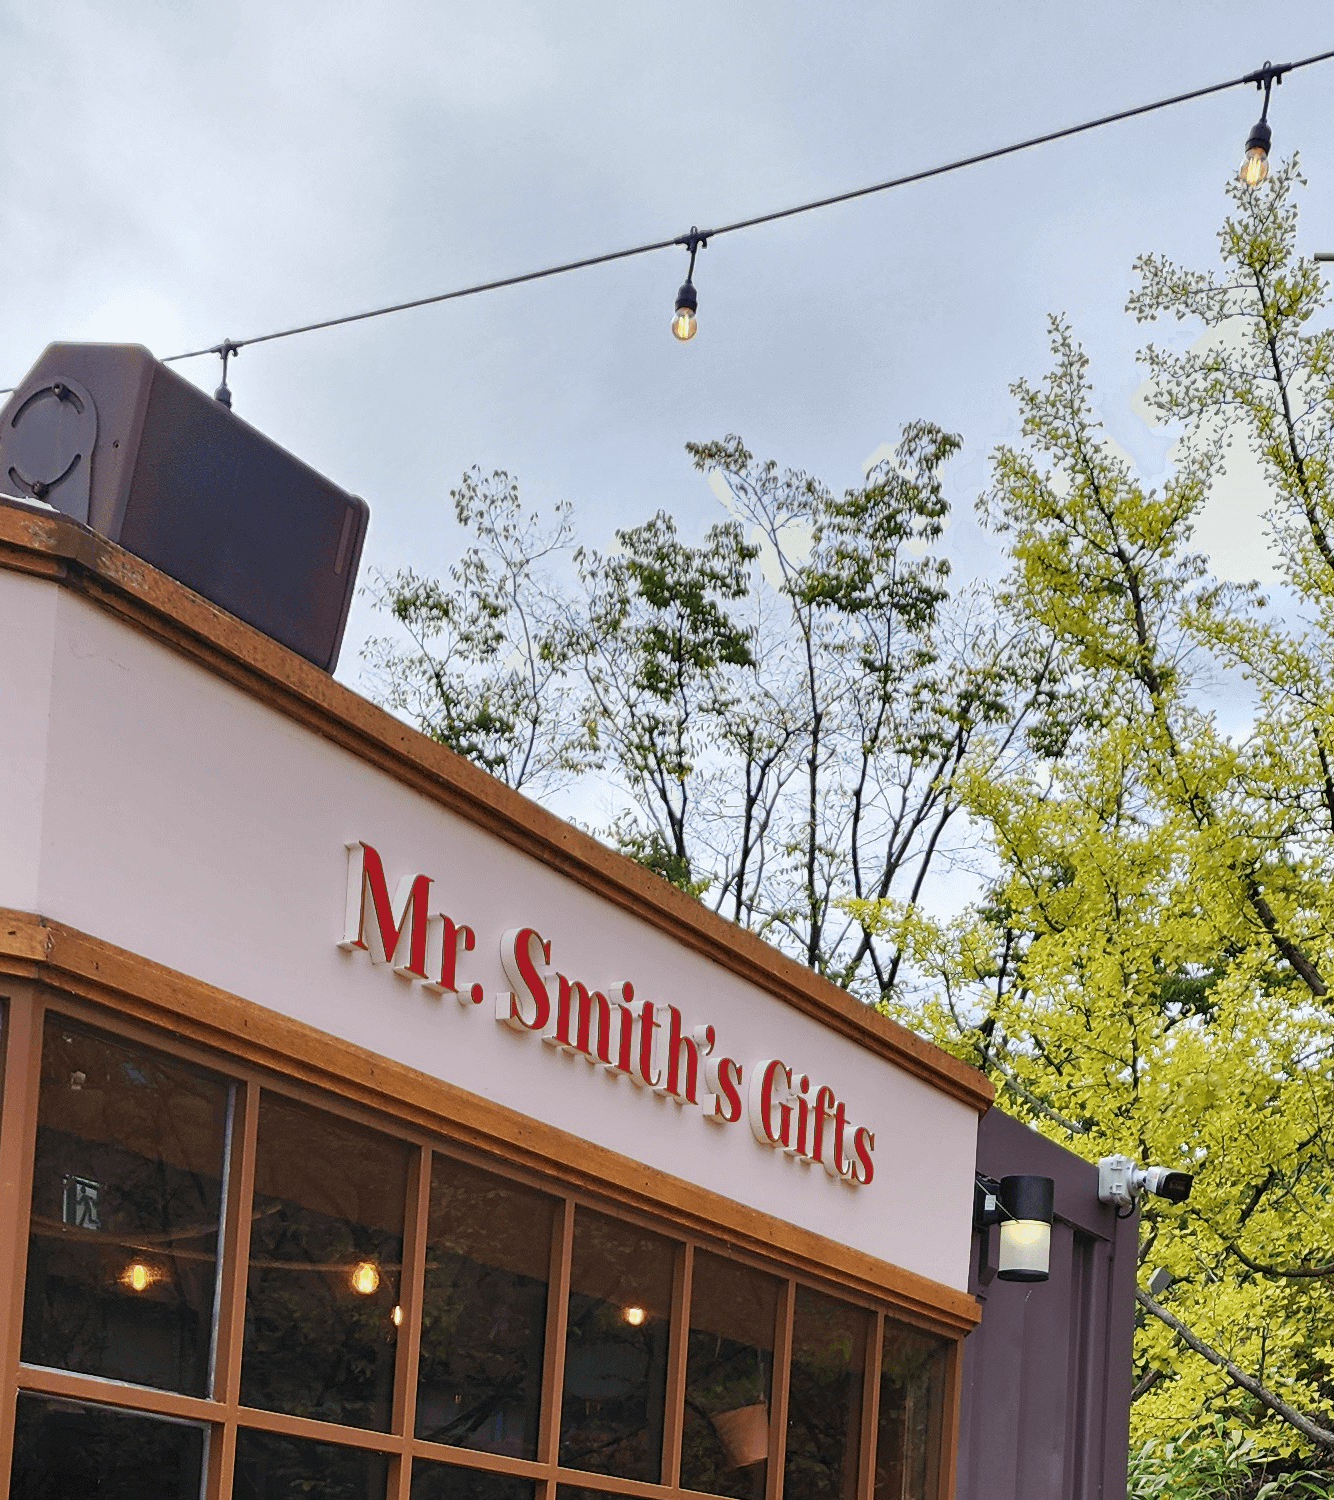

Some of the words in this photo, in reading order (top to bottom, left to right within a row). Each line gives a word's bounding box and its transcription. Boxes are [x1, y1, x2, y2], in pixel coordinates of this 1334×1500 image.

[337, 841, 484, 1006] Mr.
[495, 927, 742, 1124] Smith's
[749, 1059, 876, 1186] Gifts
